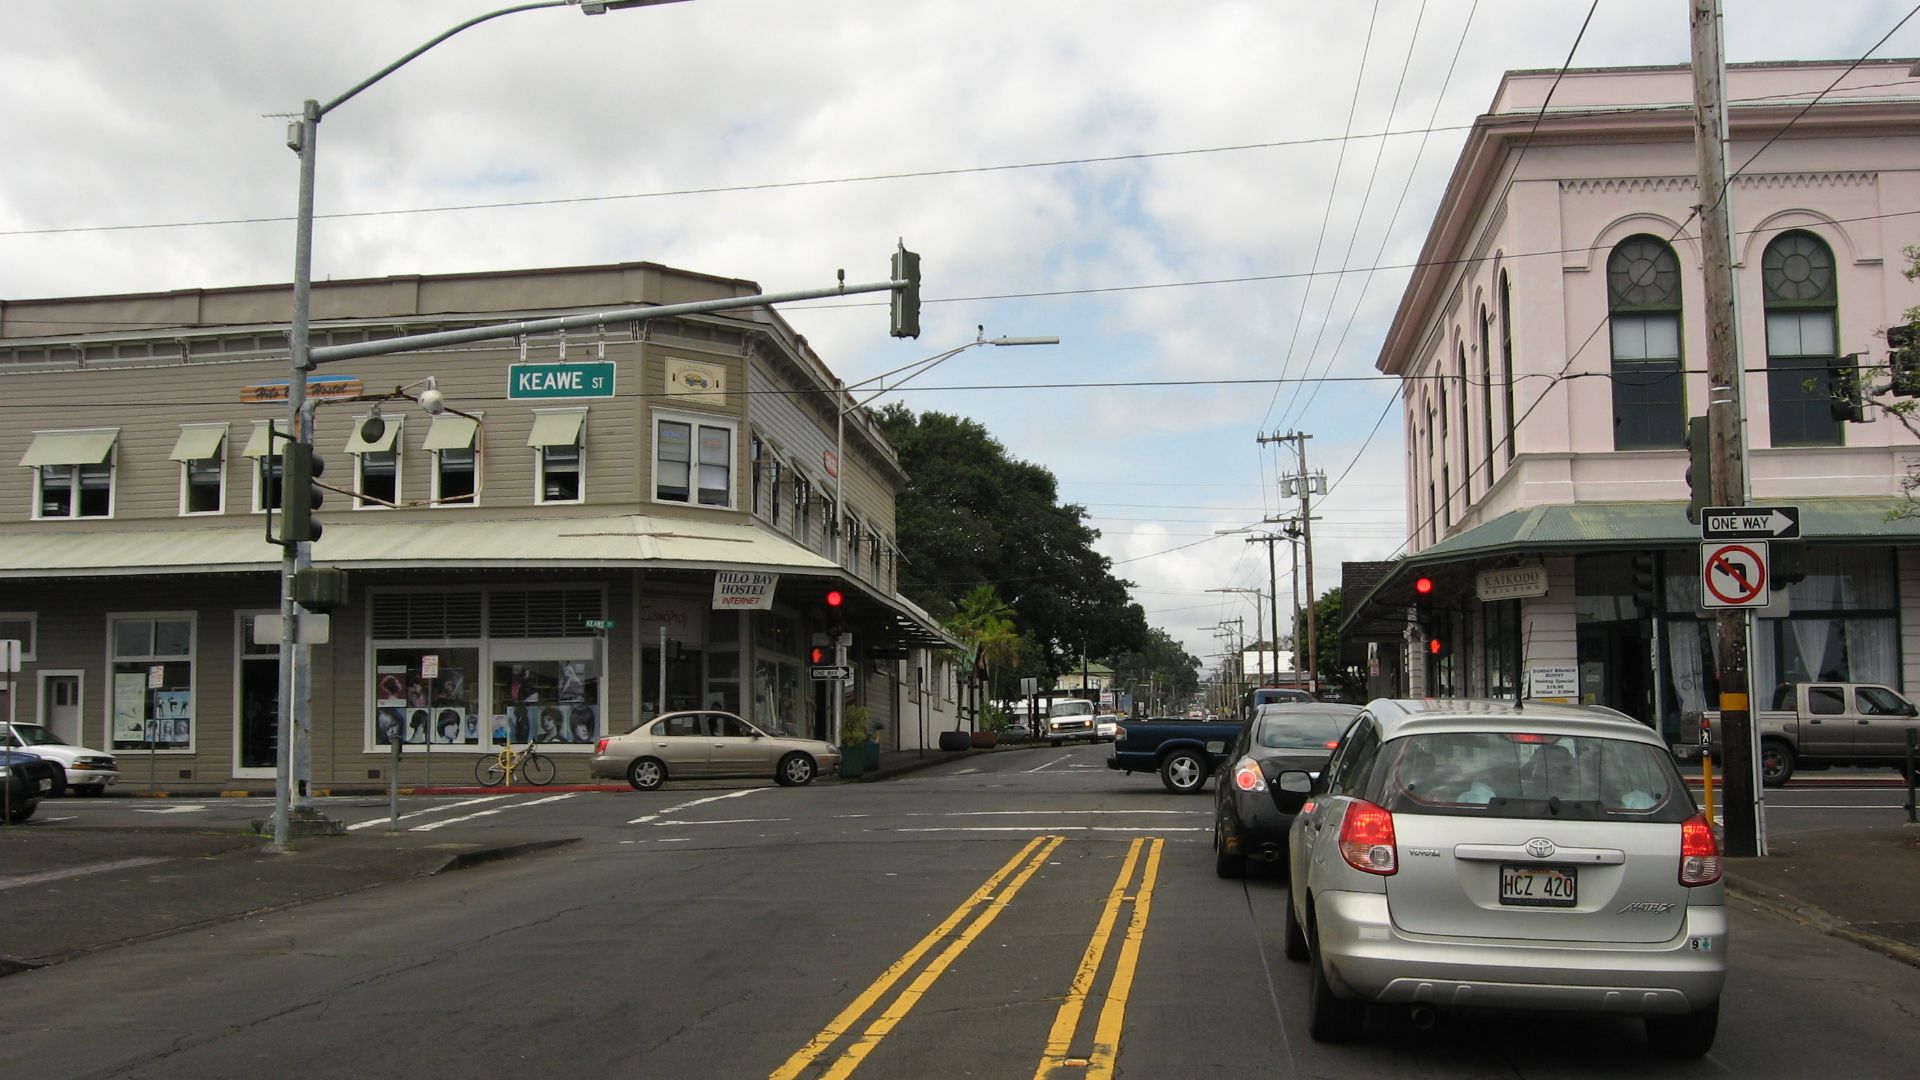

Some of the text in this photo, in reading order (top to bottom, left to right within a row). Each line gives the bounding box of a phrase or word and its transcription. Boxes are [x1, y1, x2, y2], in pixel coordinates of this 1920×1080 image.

[519, 371, 604, 391] KEAWE ST
[1711, 516, 1769, 530] ONE WAY
[719, 573, 776, 585] HILO BAY
[1484, 573, 1539, 586] KAIKODO
[721, 584, 766, 595] HOSTEL
[721, 597, 760, 605] INTERNET
[1409, 849, 1440, 857] TOYOTA
[1504, 875, 1573, 898] HCZ 420
